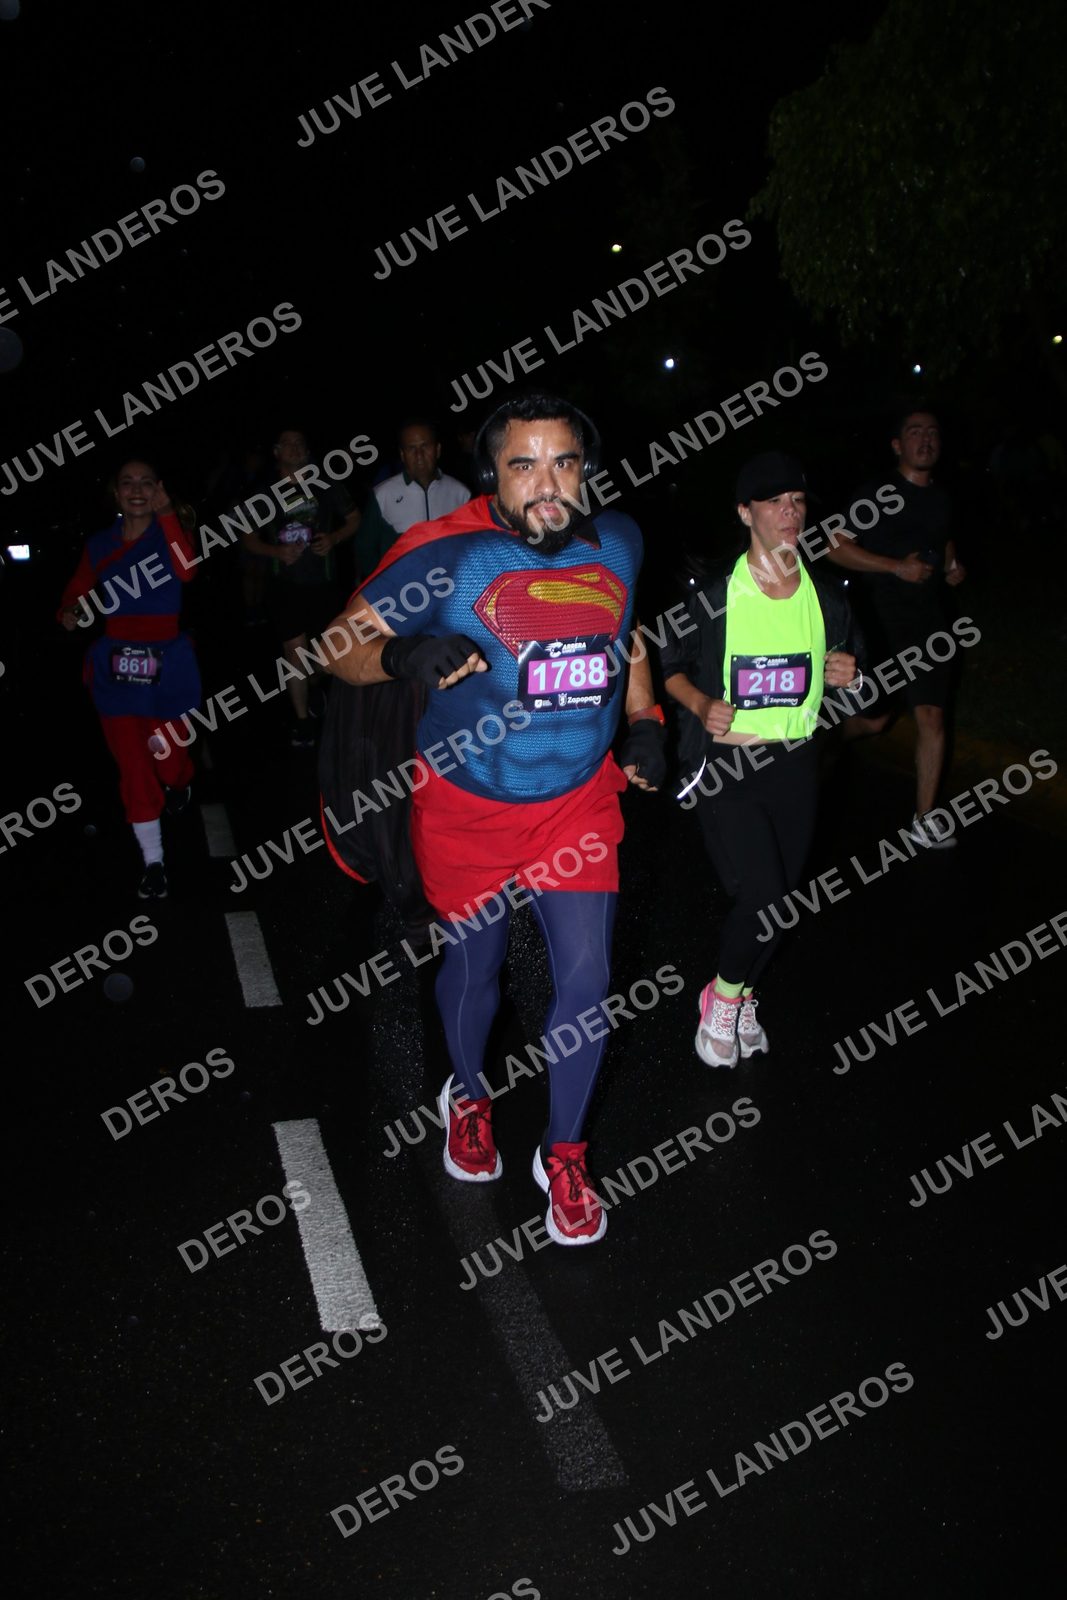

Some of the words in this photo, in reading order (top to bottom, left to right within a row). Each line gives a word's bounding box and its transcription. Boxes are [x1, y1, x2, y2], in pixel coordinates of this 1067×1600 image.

[119, 657, 148, 674] 861
[533, 656, 605, 691] 1788
[748, 670, 794, 694] 218
